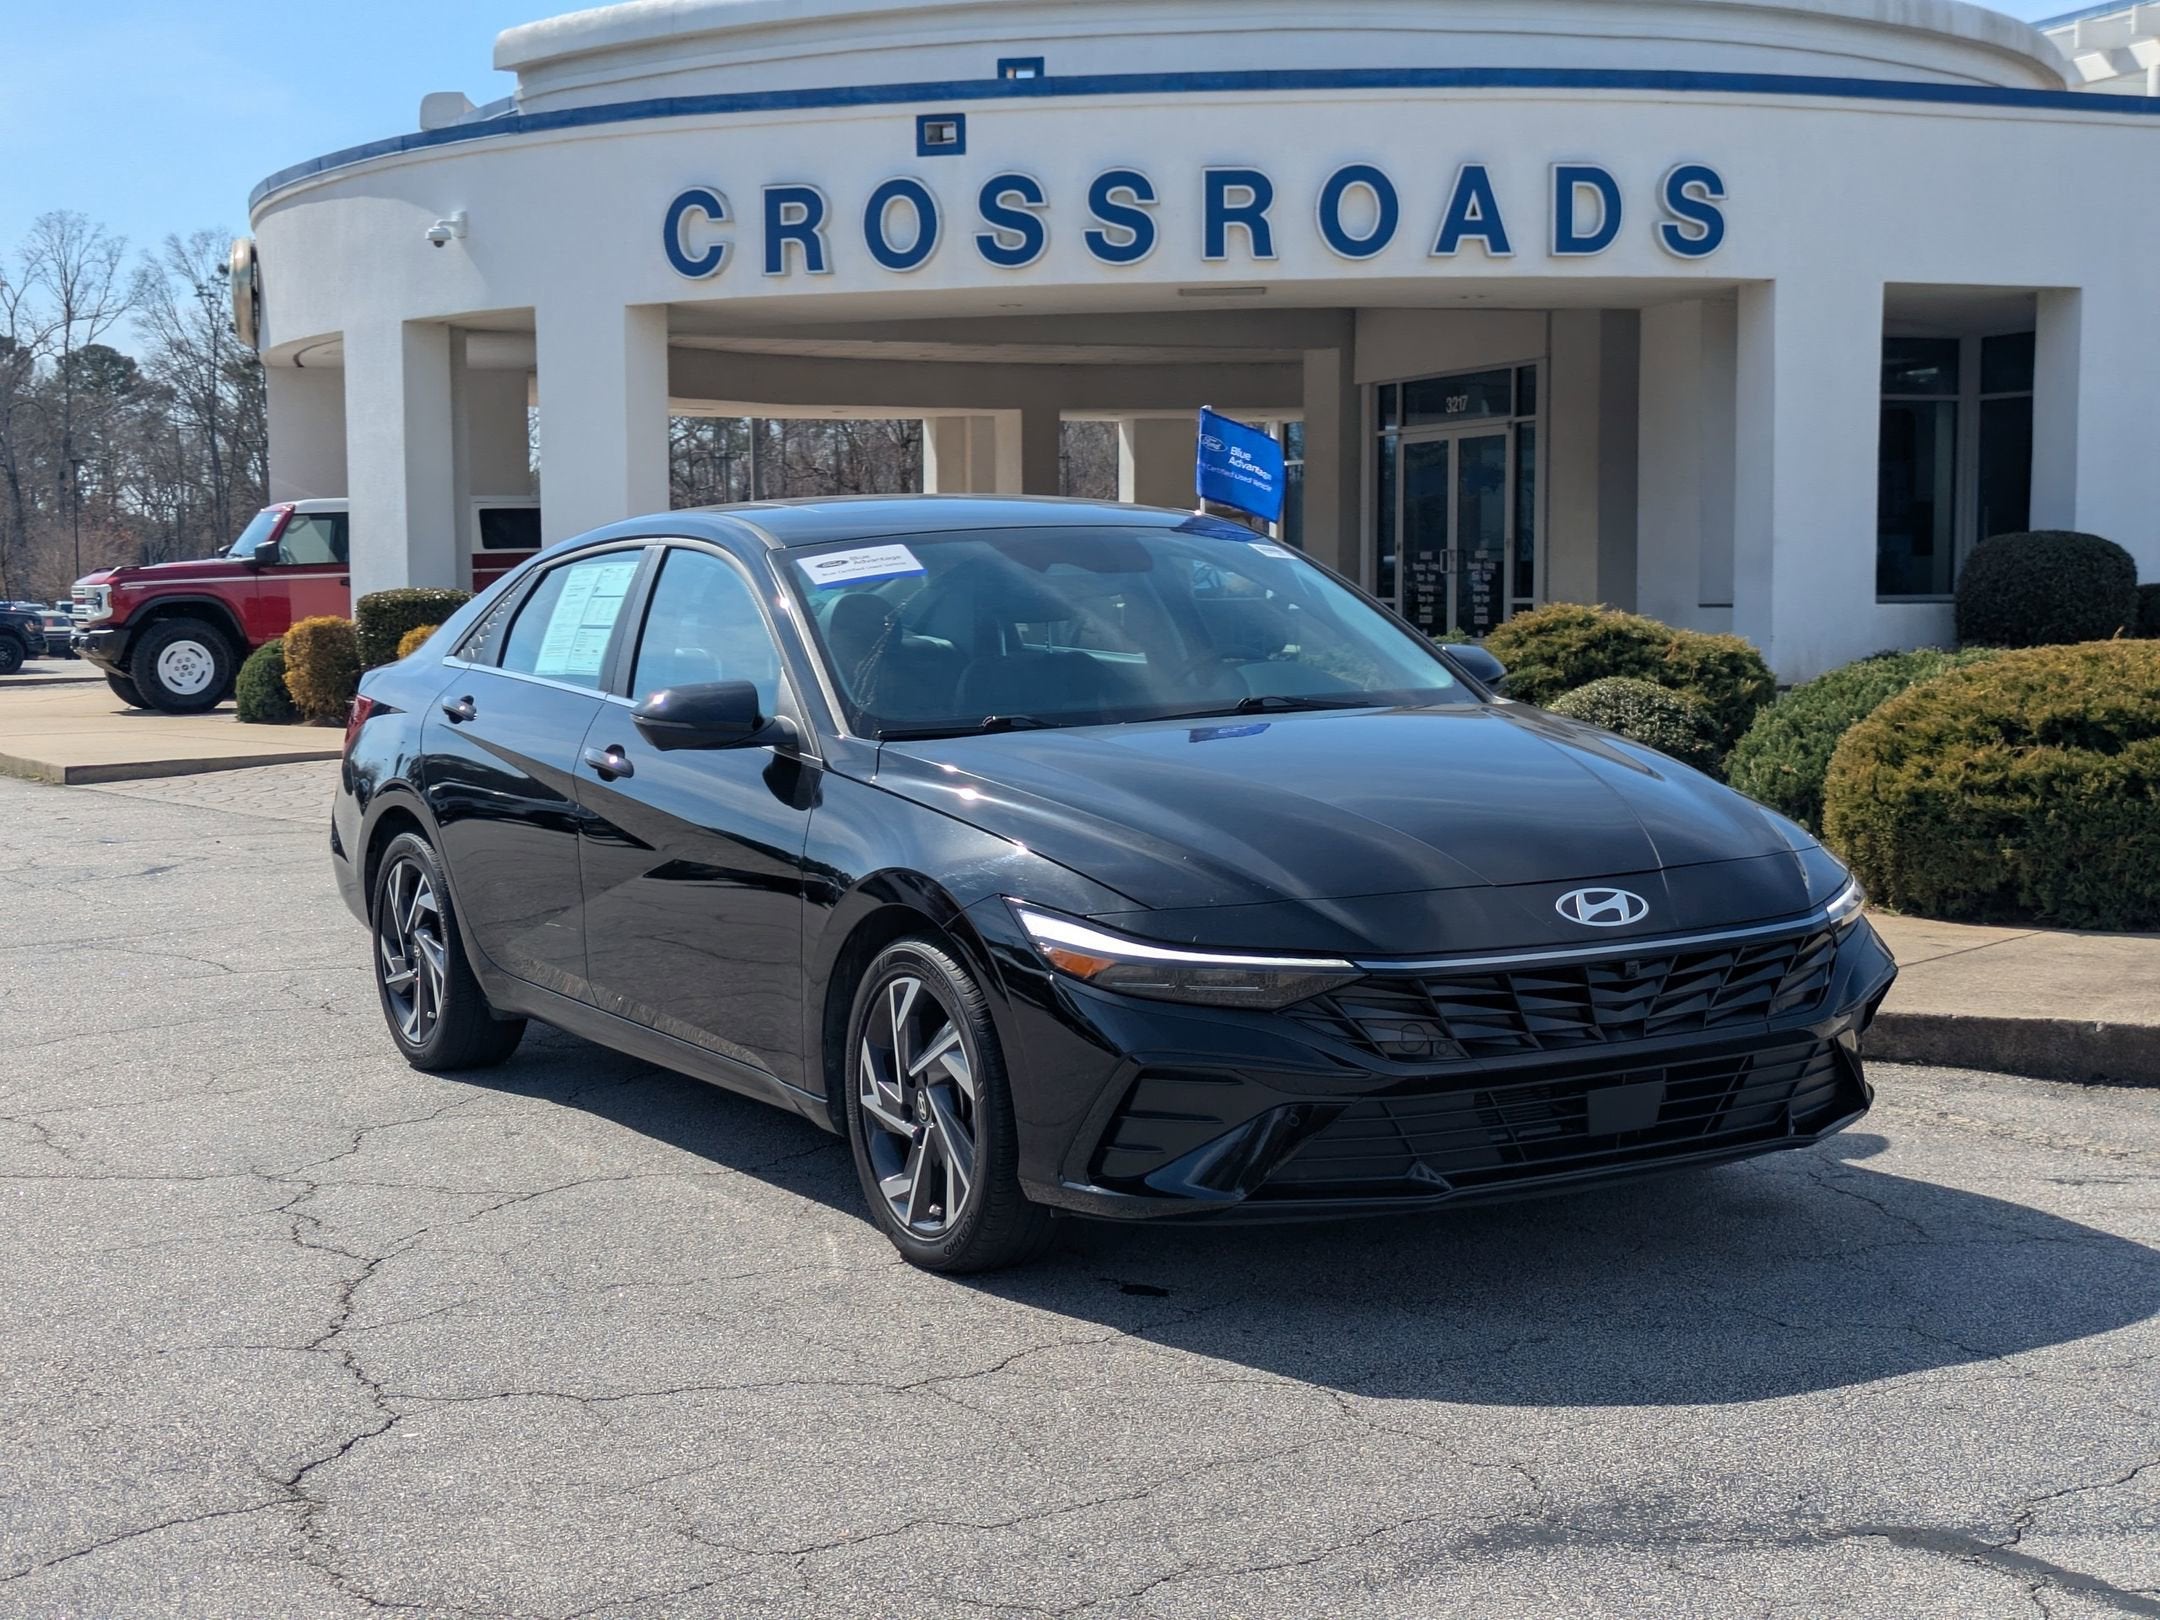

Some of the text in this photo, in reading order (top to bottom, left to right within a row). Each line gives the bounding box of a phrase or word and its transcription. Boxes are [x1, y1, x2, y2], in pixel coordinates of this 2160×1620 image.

[663, 160, 1727, 280] CROSSROADS
[1445, 394, 1468, 413] 3217
[1230, 446, 1252, 461] Blue
[943, 1210, 976, 1257] KUMHO
